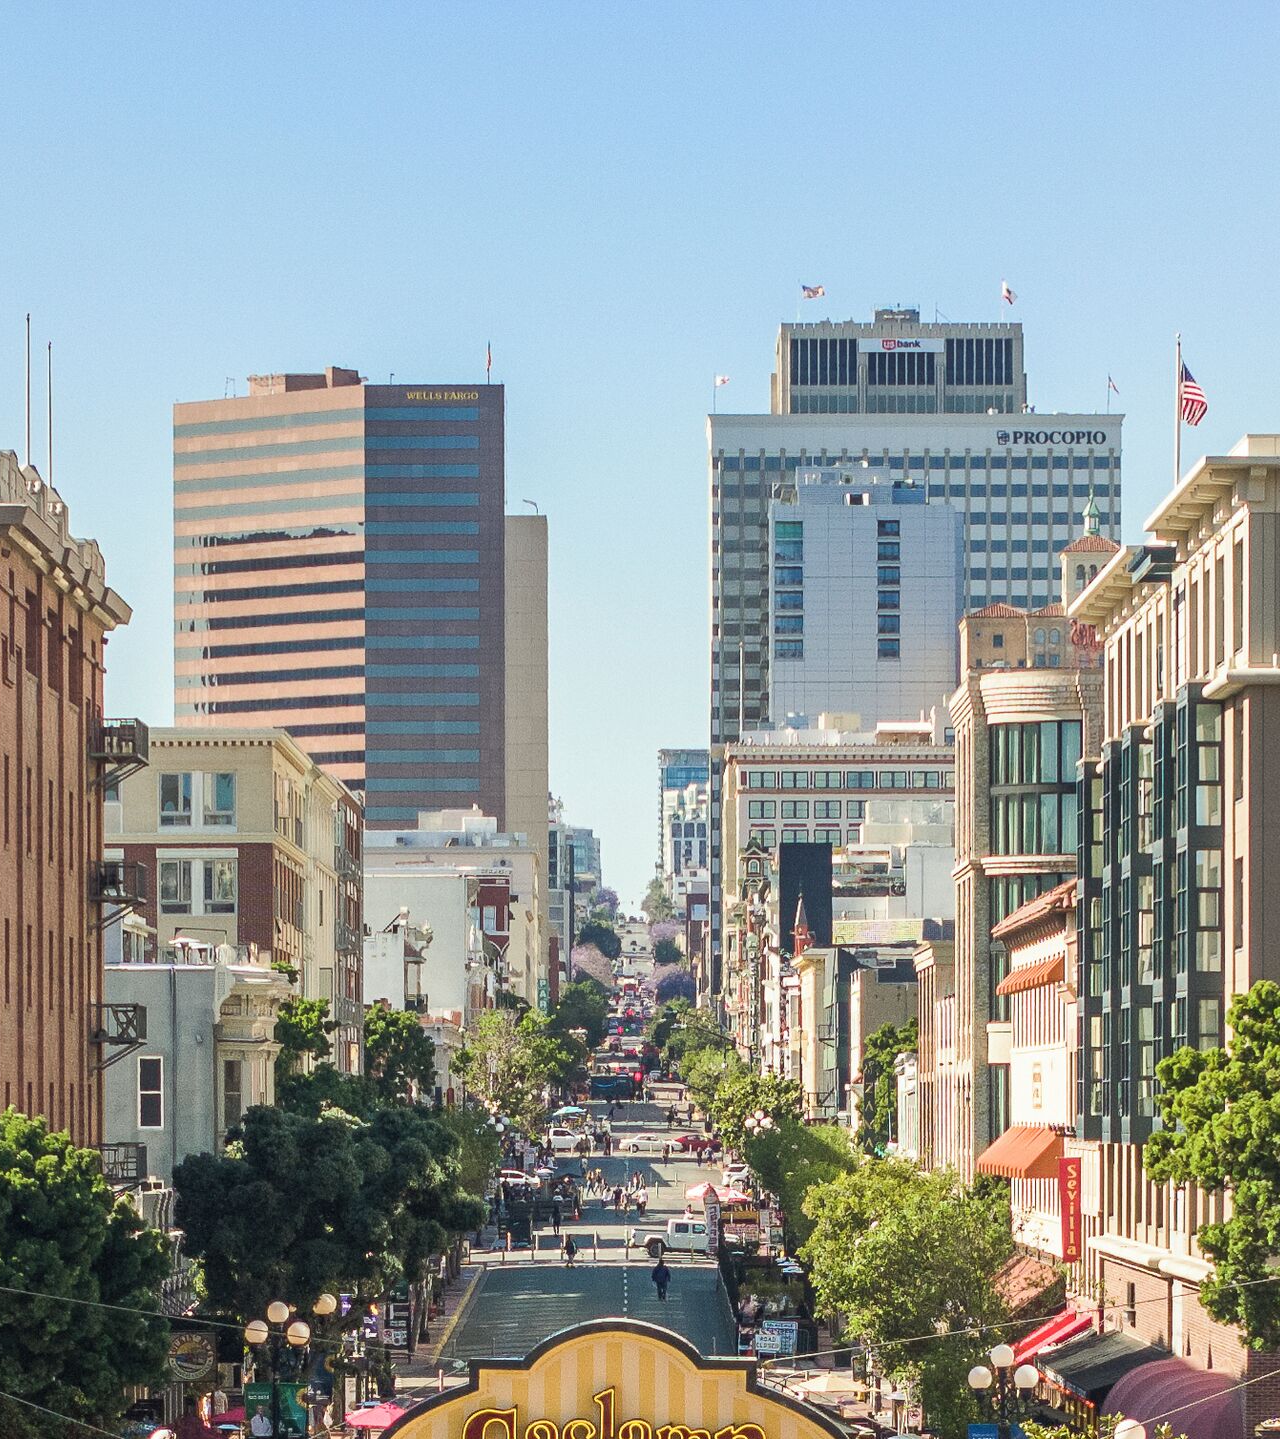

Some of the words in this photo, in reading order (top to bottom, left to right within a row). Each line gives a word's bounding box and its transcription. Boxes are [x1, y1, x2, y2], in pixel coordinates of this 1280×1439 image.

[897, 339, 921, 349] bank
[407, 391, 442, 400] WELLS
[445, 391, 479, 400] FARGO
[1012, 431, 1106, 445] PROCOPIO
[1066, 1164, 1077, 1255] Sevilla
